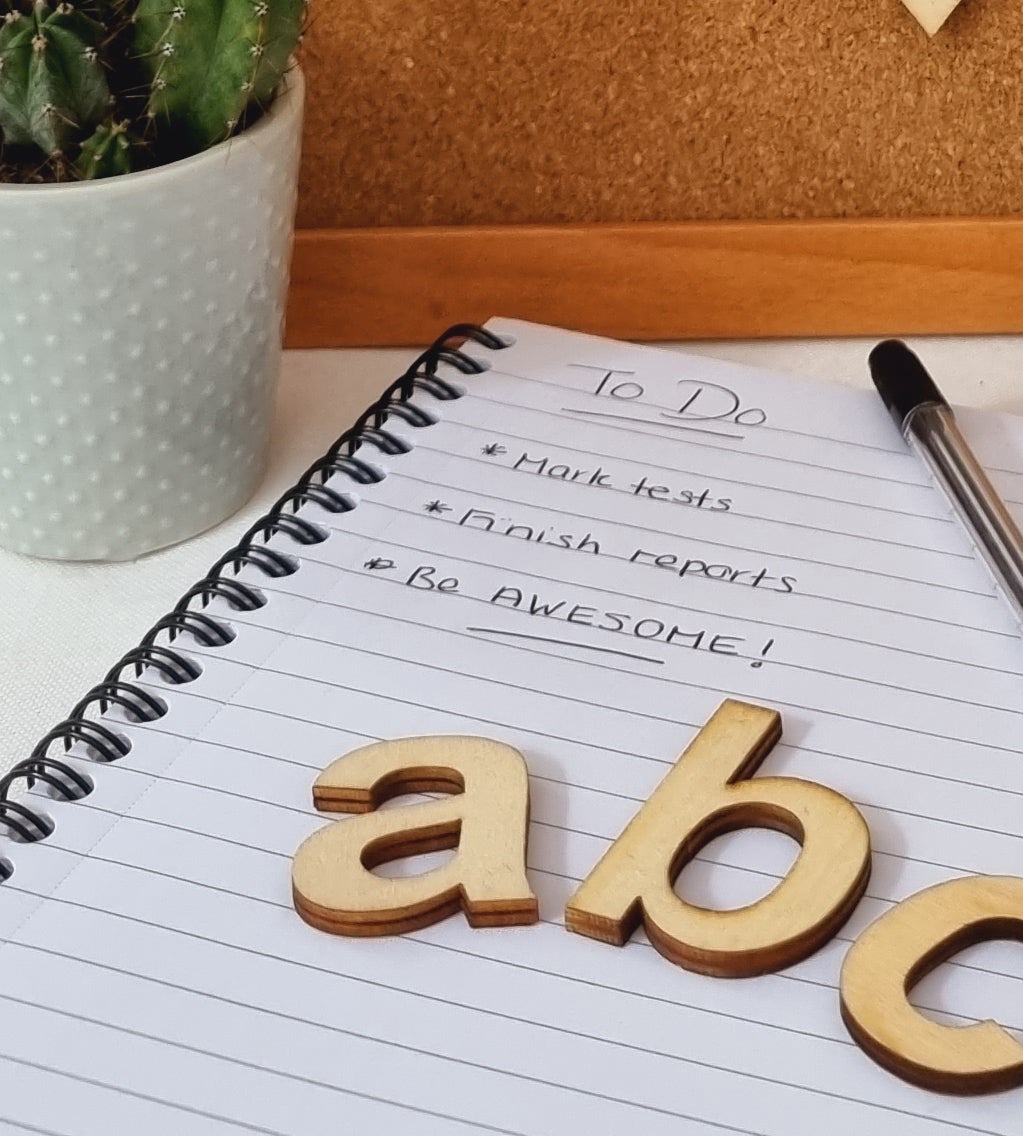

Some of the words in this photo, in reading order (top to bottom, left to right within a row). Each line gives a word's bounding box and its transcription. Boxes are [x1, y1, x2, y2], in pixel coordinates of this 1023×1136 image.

[568, 363, 644, 403] To
[659, 379, 768, 428] Do
[513, 452, 611, 489] Mark
[630, 477, 732, 513] tests
[406, 565, 460, 594] Be
[459, 507, 600, 556] Finish
[629, 548, 798, 595] reports
